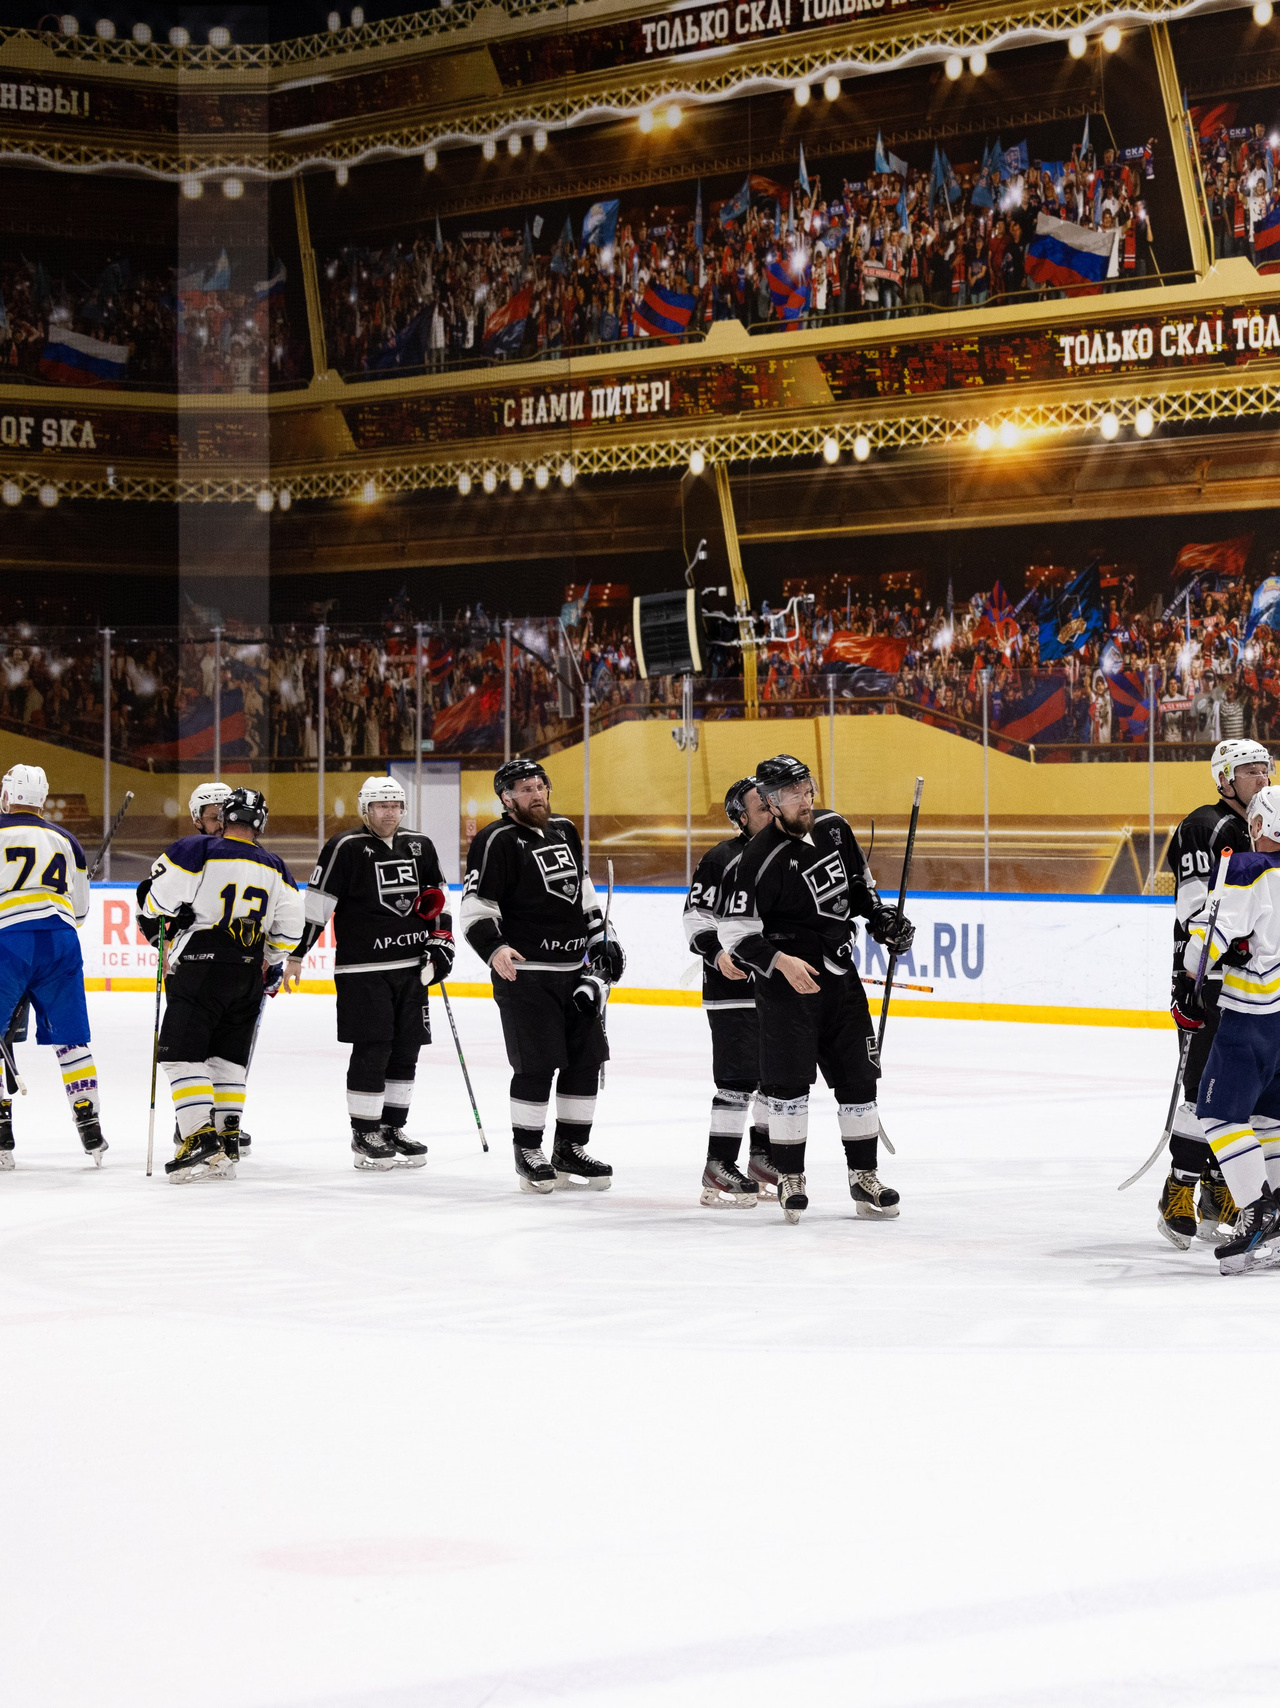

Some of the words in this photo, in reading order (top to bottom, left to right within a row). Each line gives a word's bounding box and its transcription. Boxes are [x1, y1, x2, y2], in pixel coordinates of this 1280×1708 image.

[641, 5, 730, 53] ТОЛЬКО
[735, 0, 791, 35] СКА!
[0, 83, 89, 117] НЕВЫ!
[1060, 328, 1153, 367] ТОЛЬКО
[1160, 319, 1222, 357] СКА!
[504, 399, 515, 427] С
[521, 390, 584, 426] НАМИ
[590, 380, 671, 418] ПИТЕР!
[1, 415, 35, 445] OF
[42, 418, 97, 449] SKA
[5, 847, 68, 894] 74
[379, 866, 414, 885] LR
[539, 850, 574, 872] LR
[809, 859, 845, 893] LR
[1181, 849, 1209, 878] 90
[211, 882, 269, 933] 13
[690, 883, 717, 907] 24
[103, 952, 129, 967] ICE
[1206, 1078, 1216, 1104] Reebok
